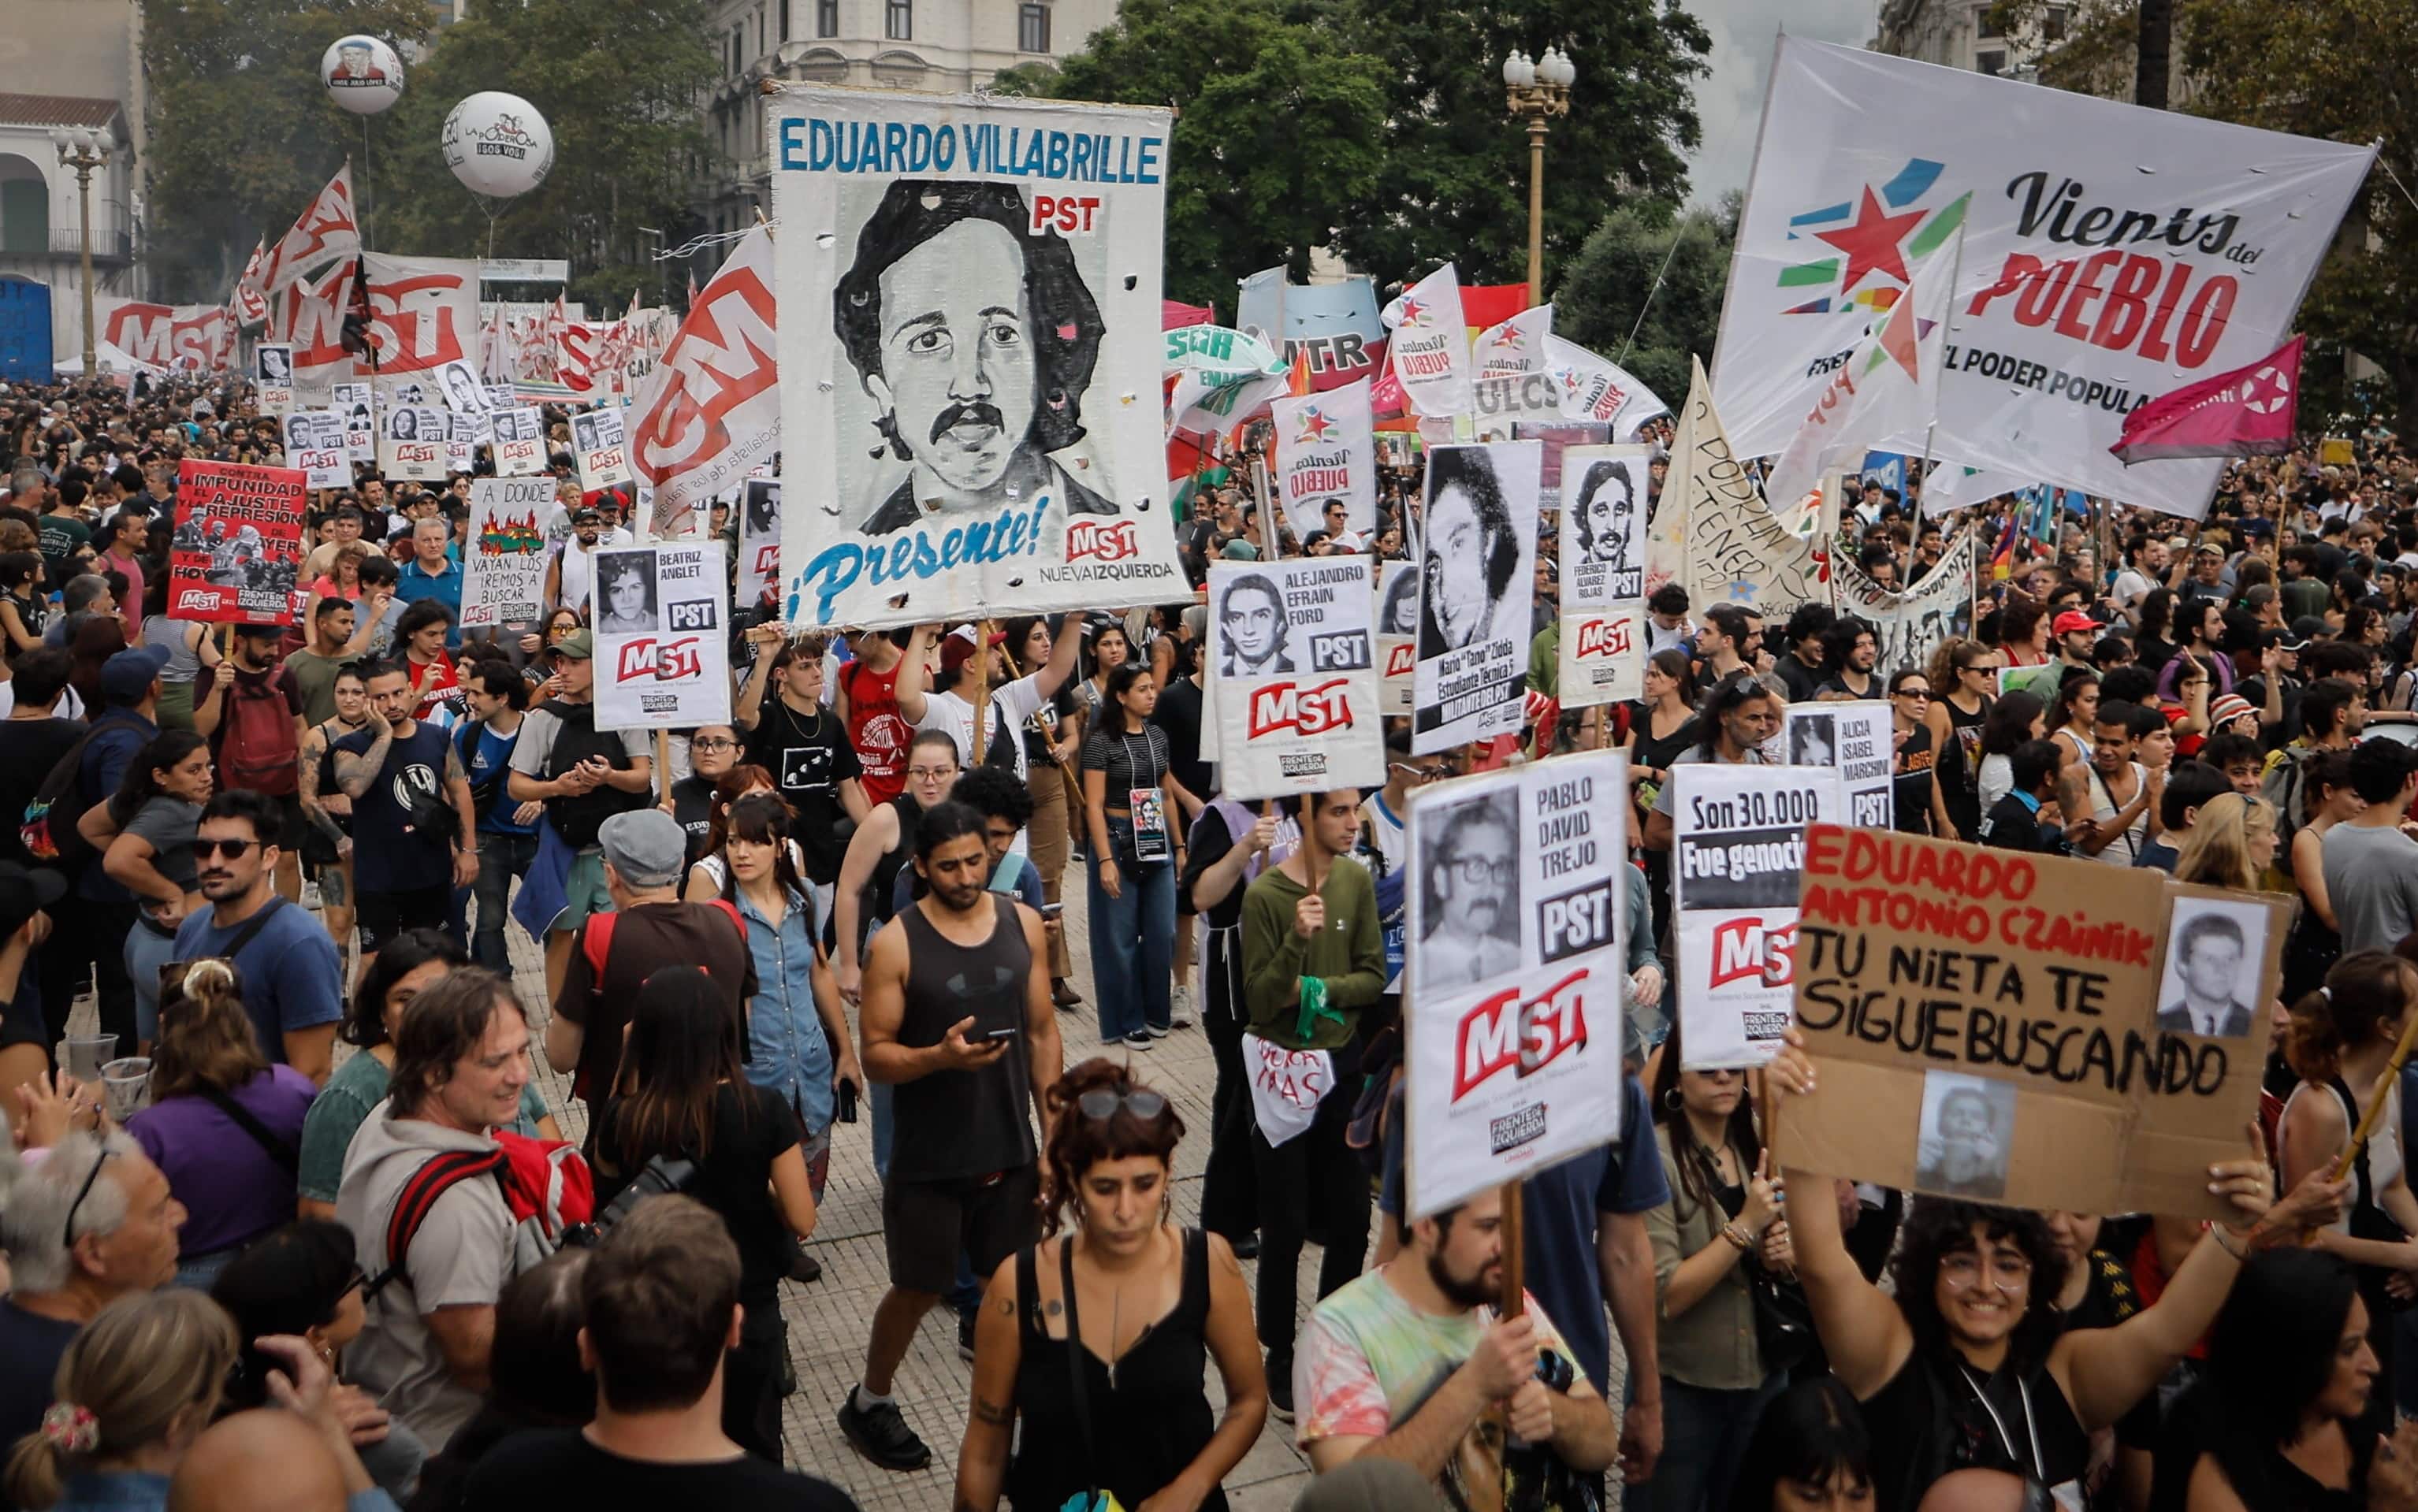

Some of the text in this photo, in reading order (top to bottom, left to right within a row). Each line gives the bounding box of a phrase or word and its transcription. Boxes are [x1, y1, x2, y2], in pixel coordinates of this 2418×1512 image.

[465, 126, 538, 149] LA PODEROSA
[779, 117, 1162, 184] EDUARDO VILLABRILLE
[1032, 194, 1099, 232] PST
[2225, 242, 2266, 266] del
[1966, 249, 2239, 370] PUEBLO
[1962, 347, 2046, 391] PODER
[2050, 370, 2156, 416] POPULA
[323, 437, 343, 447] PST
[424, 430, 442, 441] PST
[607, 432, 623, 445] PST
[301, 451, 338, 469] MST
[397, 444, 433, 462] MST
[504, 442, 534, 459] MST
[590, 448, 623, 472] MST
[220, 467, 270, 480] CONTRA
[193, 474, 303, 497] IMPUNIDAD
[483, 482, 551, 503] A DONDE
[179, 499, 188, 507] Y
[188, 500, 203, 508] LA
[194, 489, 291, 511] EL AJUSTE
[271, 528, 287, 537] DE
[1066, 520, 1136, 563] MST
[182, 553, 210, 563] Y DE
[473, 556, 542, 573] VAYAN LOS
[659, 552, 701, 567] BEATRIZ
[785, 496, 1049, 626] ¡Presente!
[173, 564, 213, 580] HOY
[529, 573, 538, 585] A
[660, 566, 701, 581] ANGLET
[1285, 565, 1363, 589] ALEJANDRO
[1574, 563, 1606, 577] FEDERICO
[1578, 586, 1603, 600] ROJAS
[1613, 570, 1640, 596] PST
[178, 589, 221, 611] MST
[237, 598, 288, 609] IZQUIERDA
[238, 590, 276, 601] FRENTE
[482, 588, 524, 604] BUSCAR
[1286, 585, 1334, 607] EFRAÍN
[463, 605, 494, 623] MST
[672, 603, 712, 628] PST
[1289, 608, 1324, 626] FORD
[1577, 618, 1631, 658] MST
[617, 637, 701, 682] MST
[1315, 635, 1364, 667] PST
[1438, 655, 1460, 678] Mario
[1491, 638, 1513, 660] Zidda
[1438, 673, 1479, 700] Estudiante
[1479, 663, 1508, 684] Técnica
[1248, 678, 1353, 741] MST
[1842, 719, 1871, 739] ALICIA
[1842, 738, 1874, 760] ISABEL
[1281, 756, 1311, 766] FRENTE
[1537, 775, 1594, 815] PABLO
[1691, 789, 1818, 830] Son 30.000
[1854, 793, 1888, 828] PST
[1538, 811, 1590, 849] DAVID
[1539, 841, 1596, 879] TREJO
[1681, 833, 1806, 882] Fue genoci
[1805, 823, 2037, 901] EDUARDO
[1542, 889, 1612, 956] PST
[1800, 925, 1866, 979] TU
[2044, 966, 2110, 1016] TE
[1744, 1013, 1775, 1025] FRENTE
[1745, 1023, 1784, 1037] IZQUIERD
[1451, 968, 1590, 1103] MST
[1491, 1117, 1545, 1147] IZQUIERDA
[1492, 1109, 1531, 1135] FRENTE
